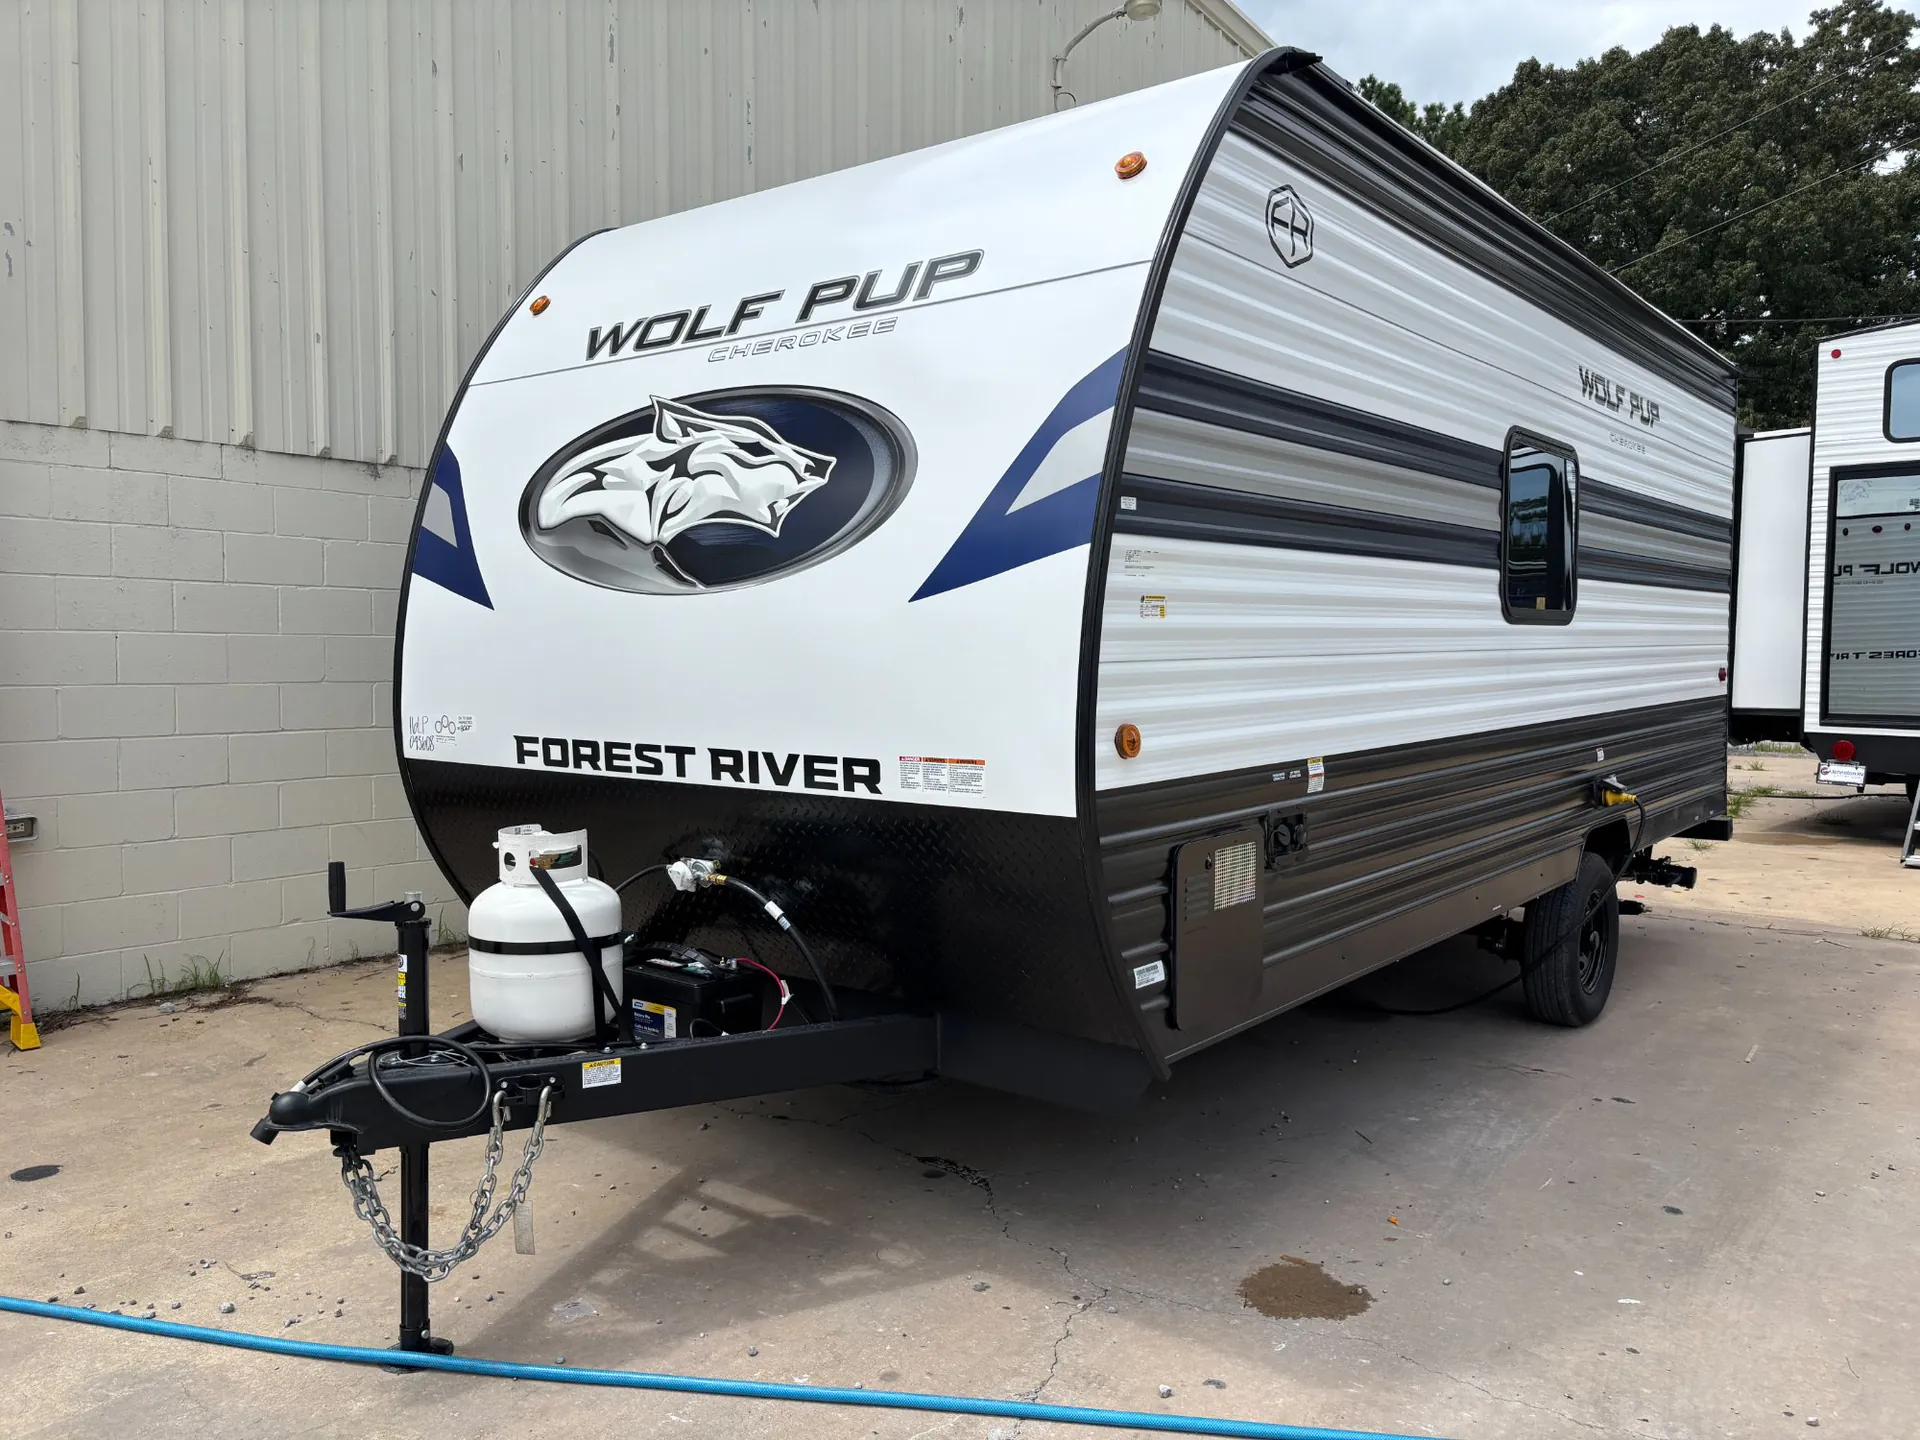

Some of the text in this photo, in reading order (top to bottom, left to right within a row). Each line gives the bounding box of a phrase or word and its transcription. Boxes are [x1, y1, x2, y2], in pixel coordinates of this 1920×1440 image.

[586, 249, 985, 361] WOLF PUP
[708, 316, 898, 363] CHEROKEE
[1578, 365, 1661, 428] WOLF PUP
[513, 734, 696, 778] FOREST
[707, 747, 883, 795] RIVER
